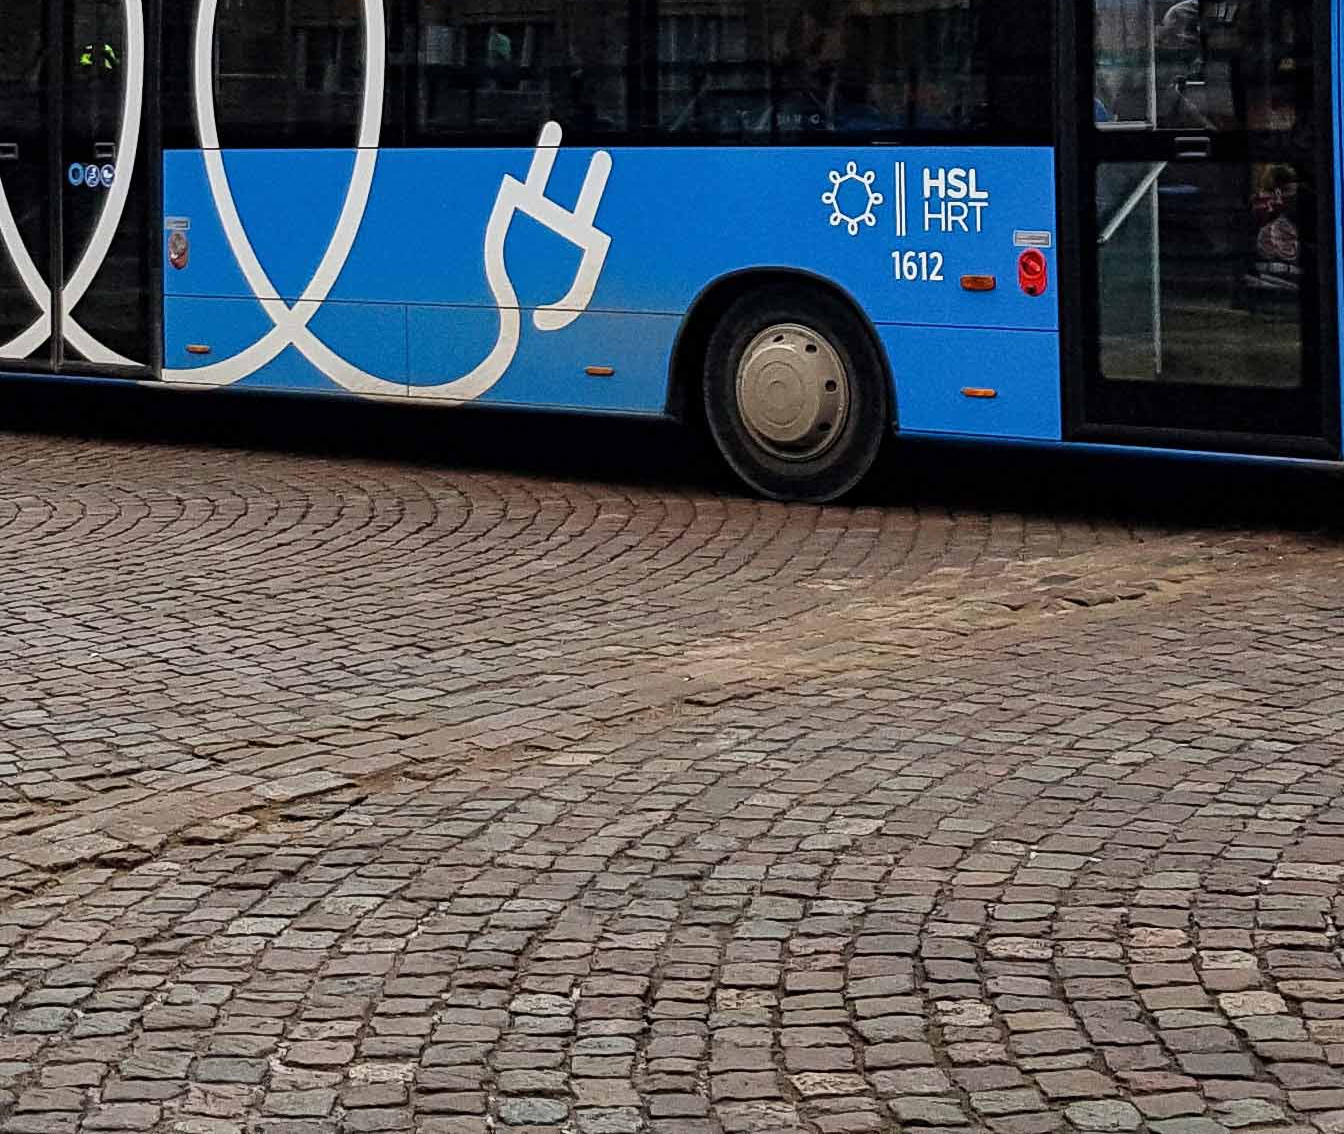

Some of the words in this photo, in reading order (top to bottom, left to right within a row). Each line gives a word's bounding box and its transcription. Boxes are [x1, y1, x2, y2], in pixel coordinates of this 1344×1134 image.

[923, 168, 989, 198] HSL
[924, 201, 989, 232] HRT
[891, 251, 944, 281] 1612
